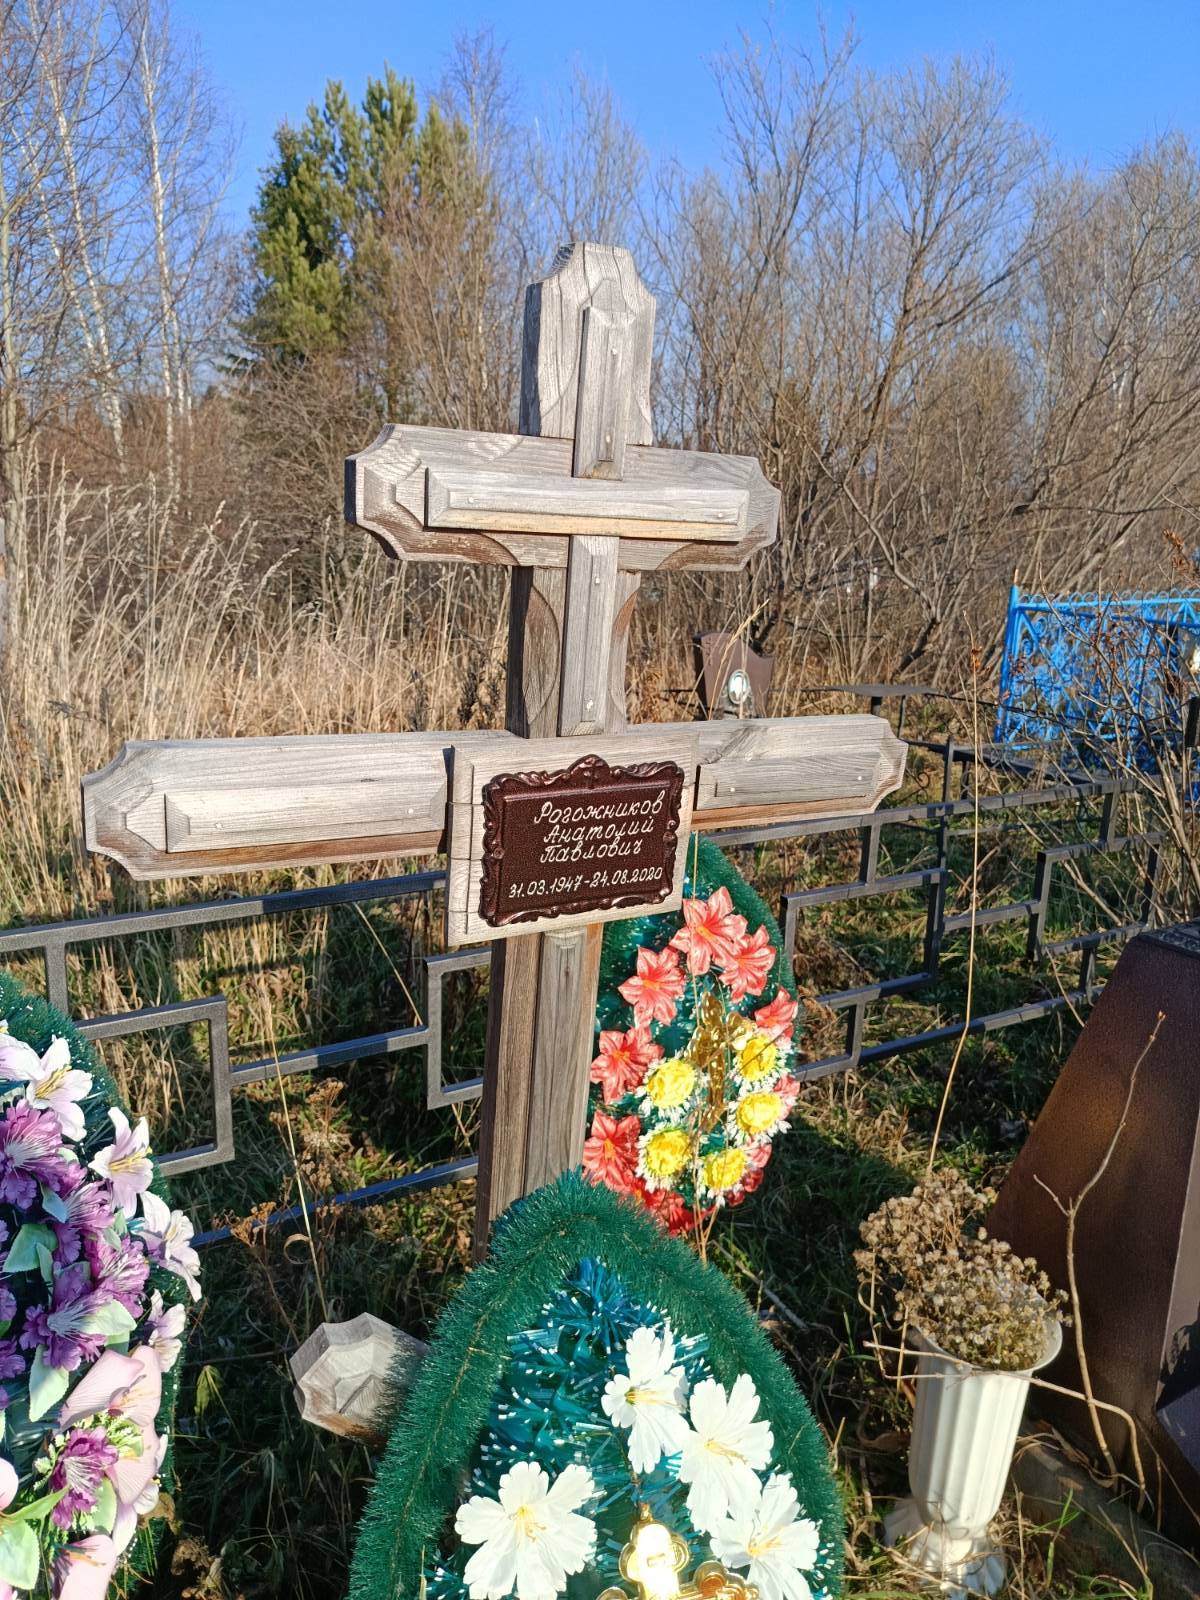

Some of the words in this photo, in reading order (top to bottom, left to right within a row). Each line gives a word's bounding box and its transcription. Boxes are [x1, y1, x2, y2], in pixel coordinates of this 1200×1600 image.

[534, 790, 666, 824] Рогожников
[543, 815, 654, 844] Анатолий
[540, 836, 643, 864] Павлович
